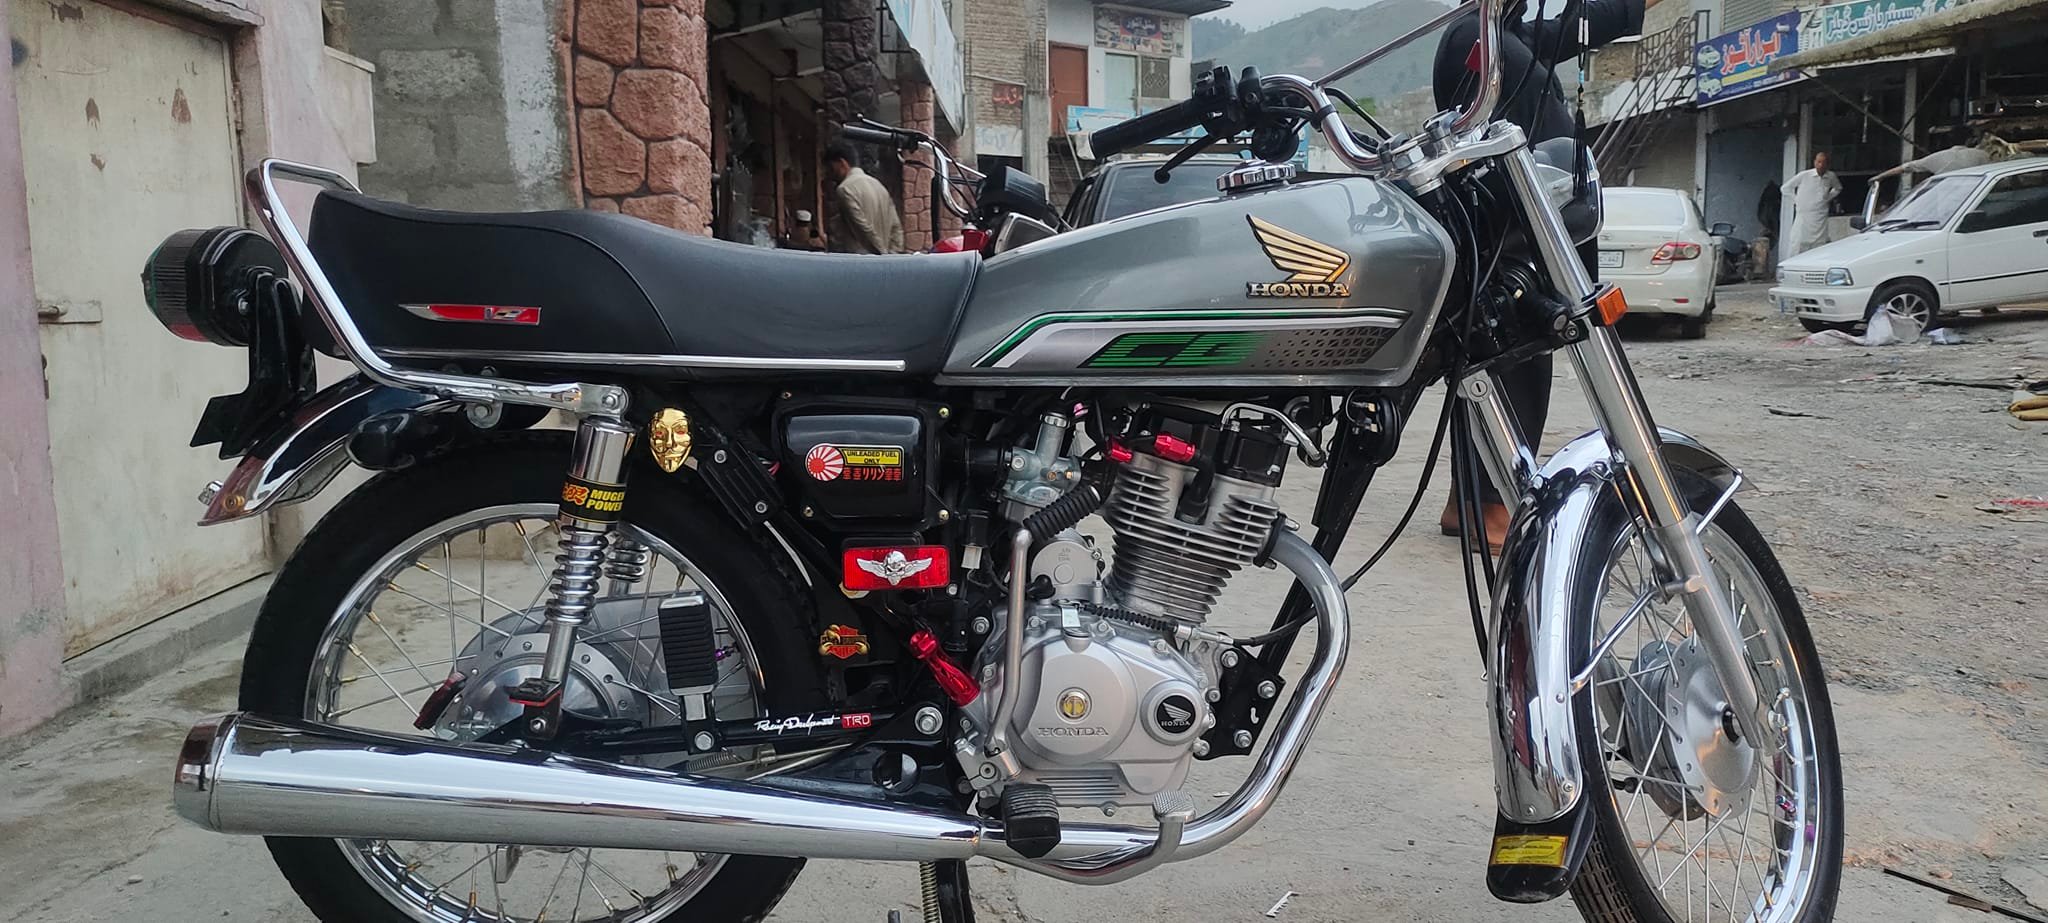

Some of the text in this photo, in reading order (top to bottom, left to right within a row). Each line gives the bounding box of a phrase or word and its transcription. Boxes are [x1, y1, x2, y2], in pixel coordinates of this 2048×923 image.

[1247, 282, 1351, 298] HONDA
[844, 715, 870, 727] TRD
[1160, 719, 1191, 727] HONDA
[1038, 727, 1109, 736] HONDA
